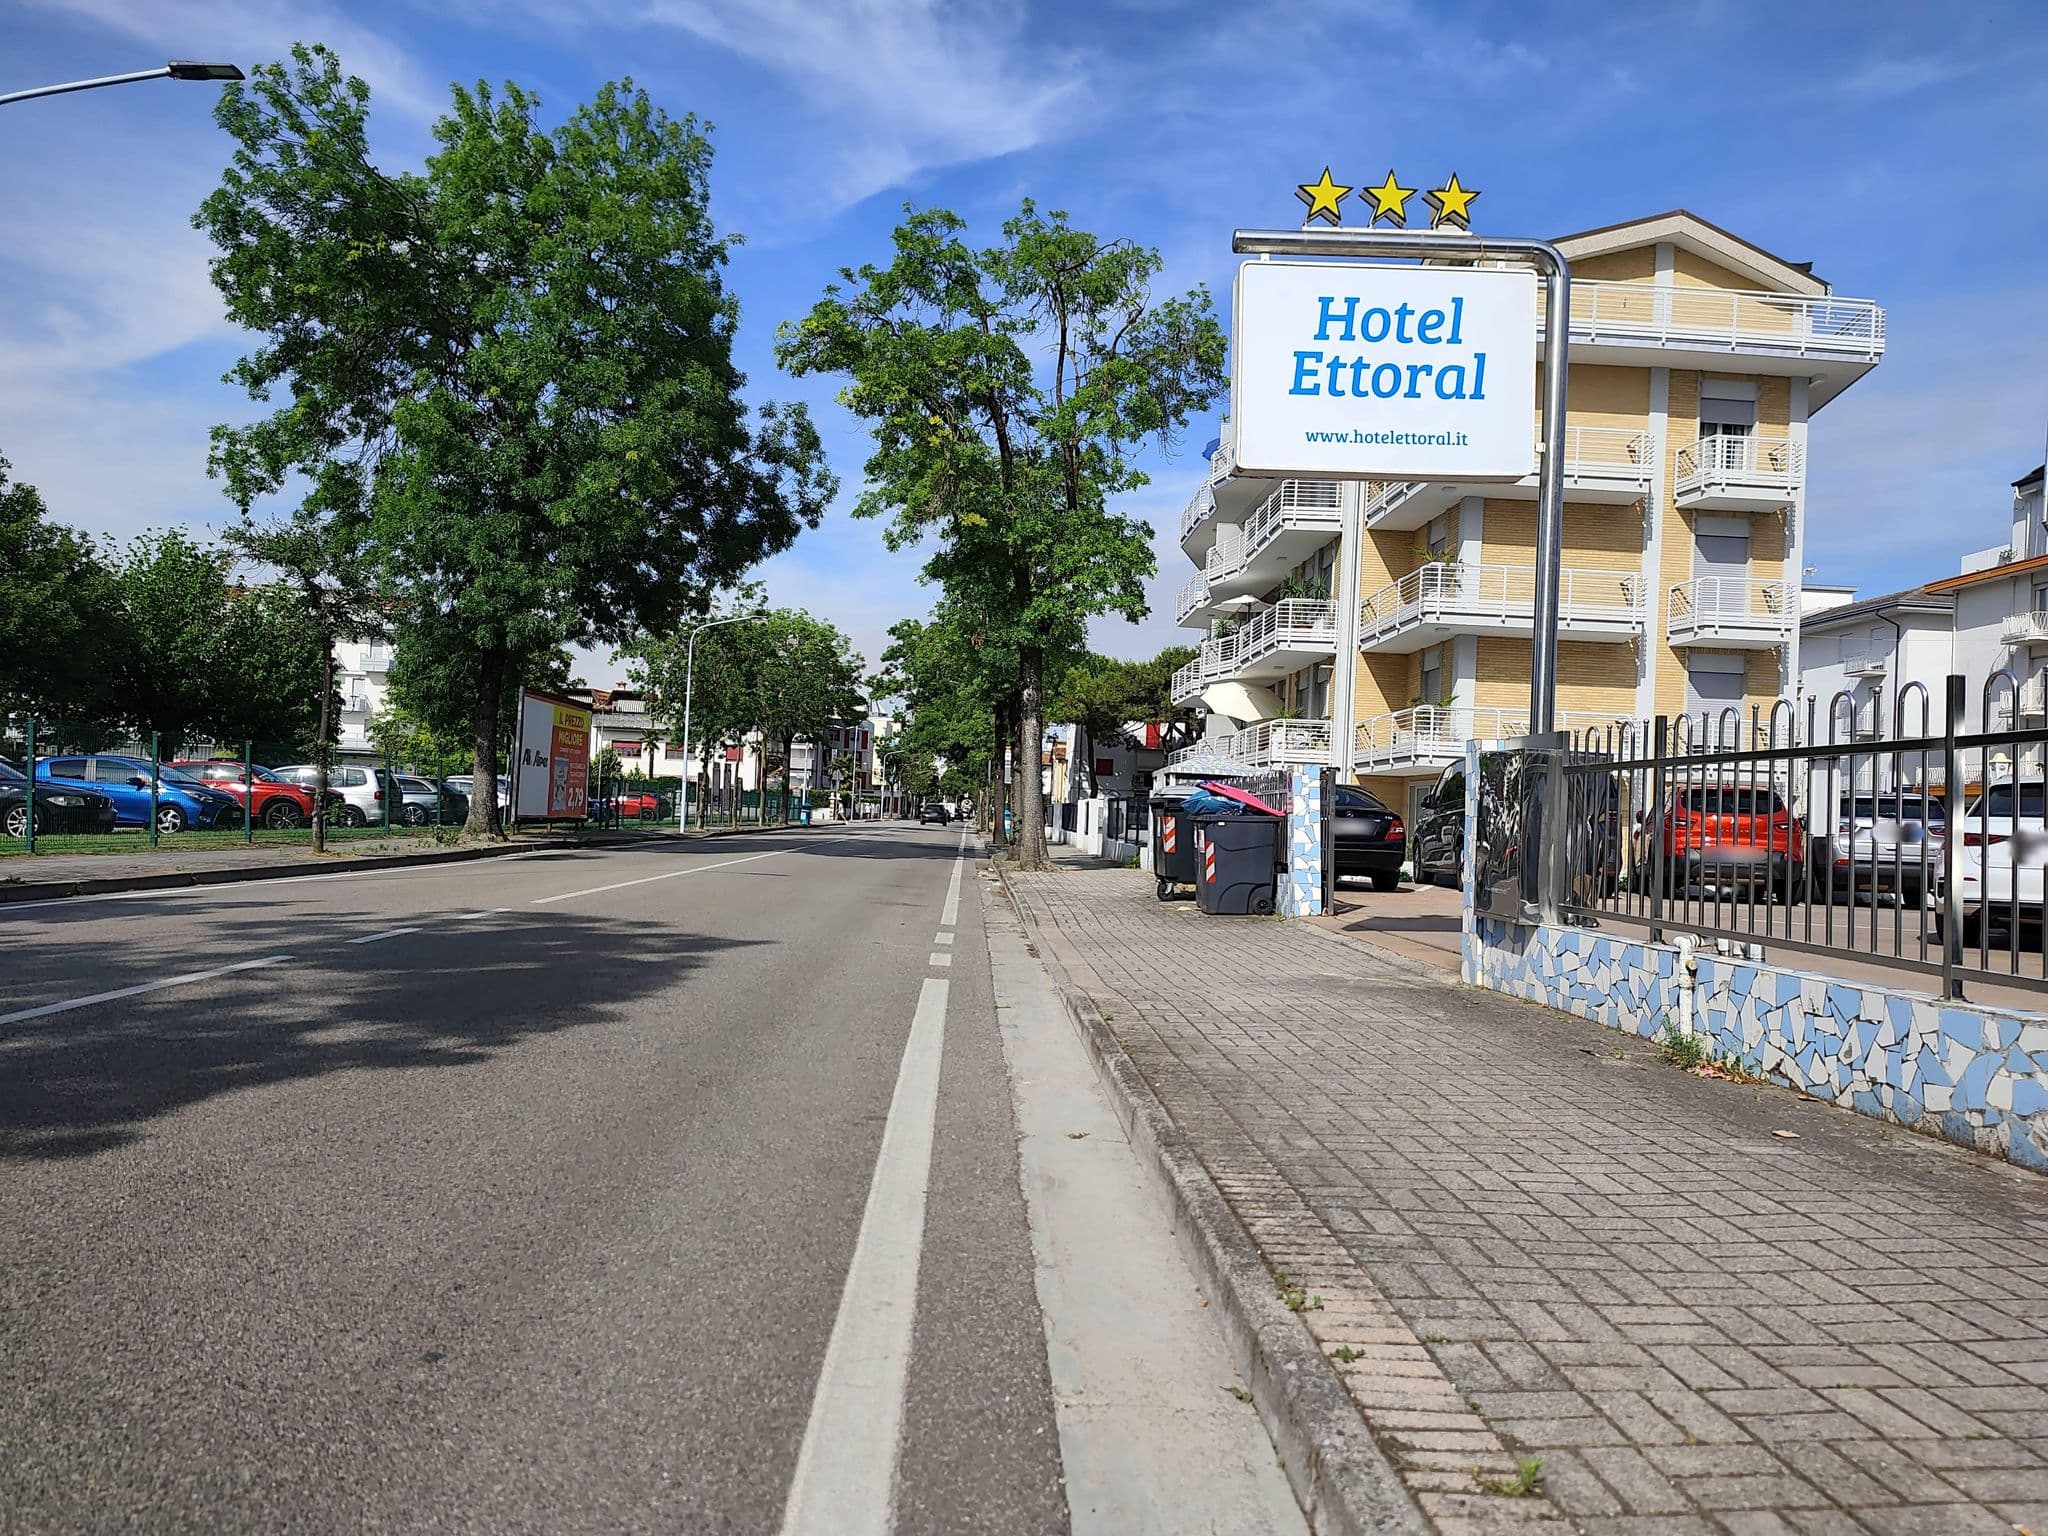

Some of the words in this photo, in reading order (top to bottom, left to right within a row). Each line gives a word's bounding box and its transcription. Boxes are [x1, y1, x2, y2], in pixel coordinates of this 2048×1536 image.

[1313, 296, 1464, 345] Hotel
[1288, 350, 1487, 401] Ettoral
[1304, 428, 1469, 447] www.hotelettoral.it
[565, 713, 584, 728] PREZZO
[559, 730, 583, 746] MIGLIORE
